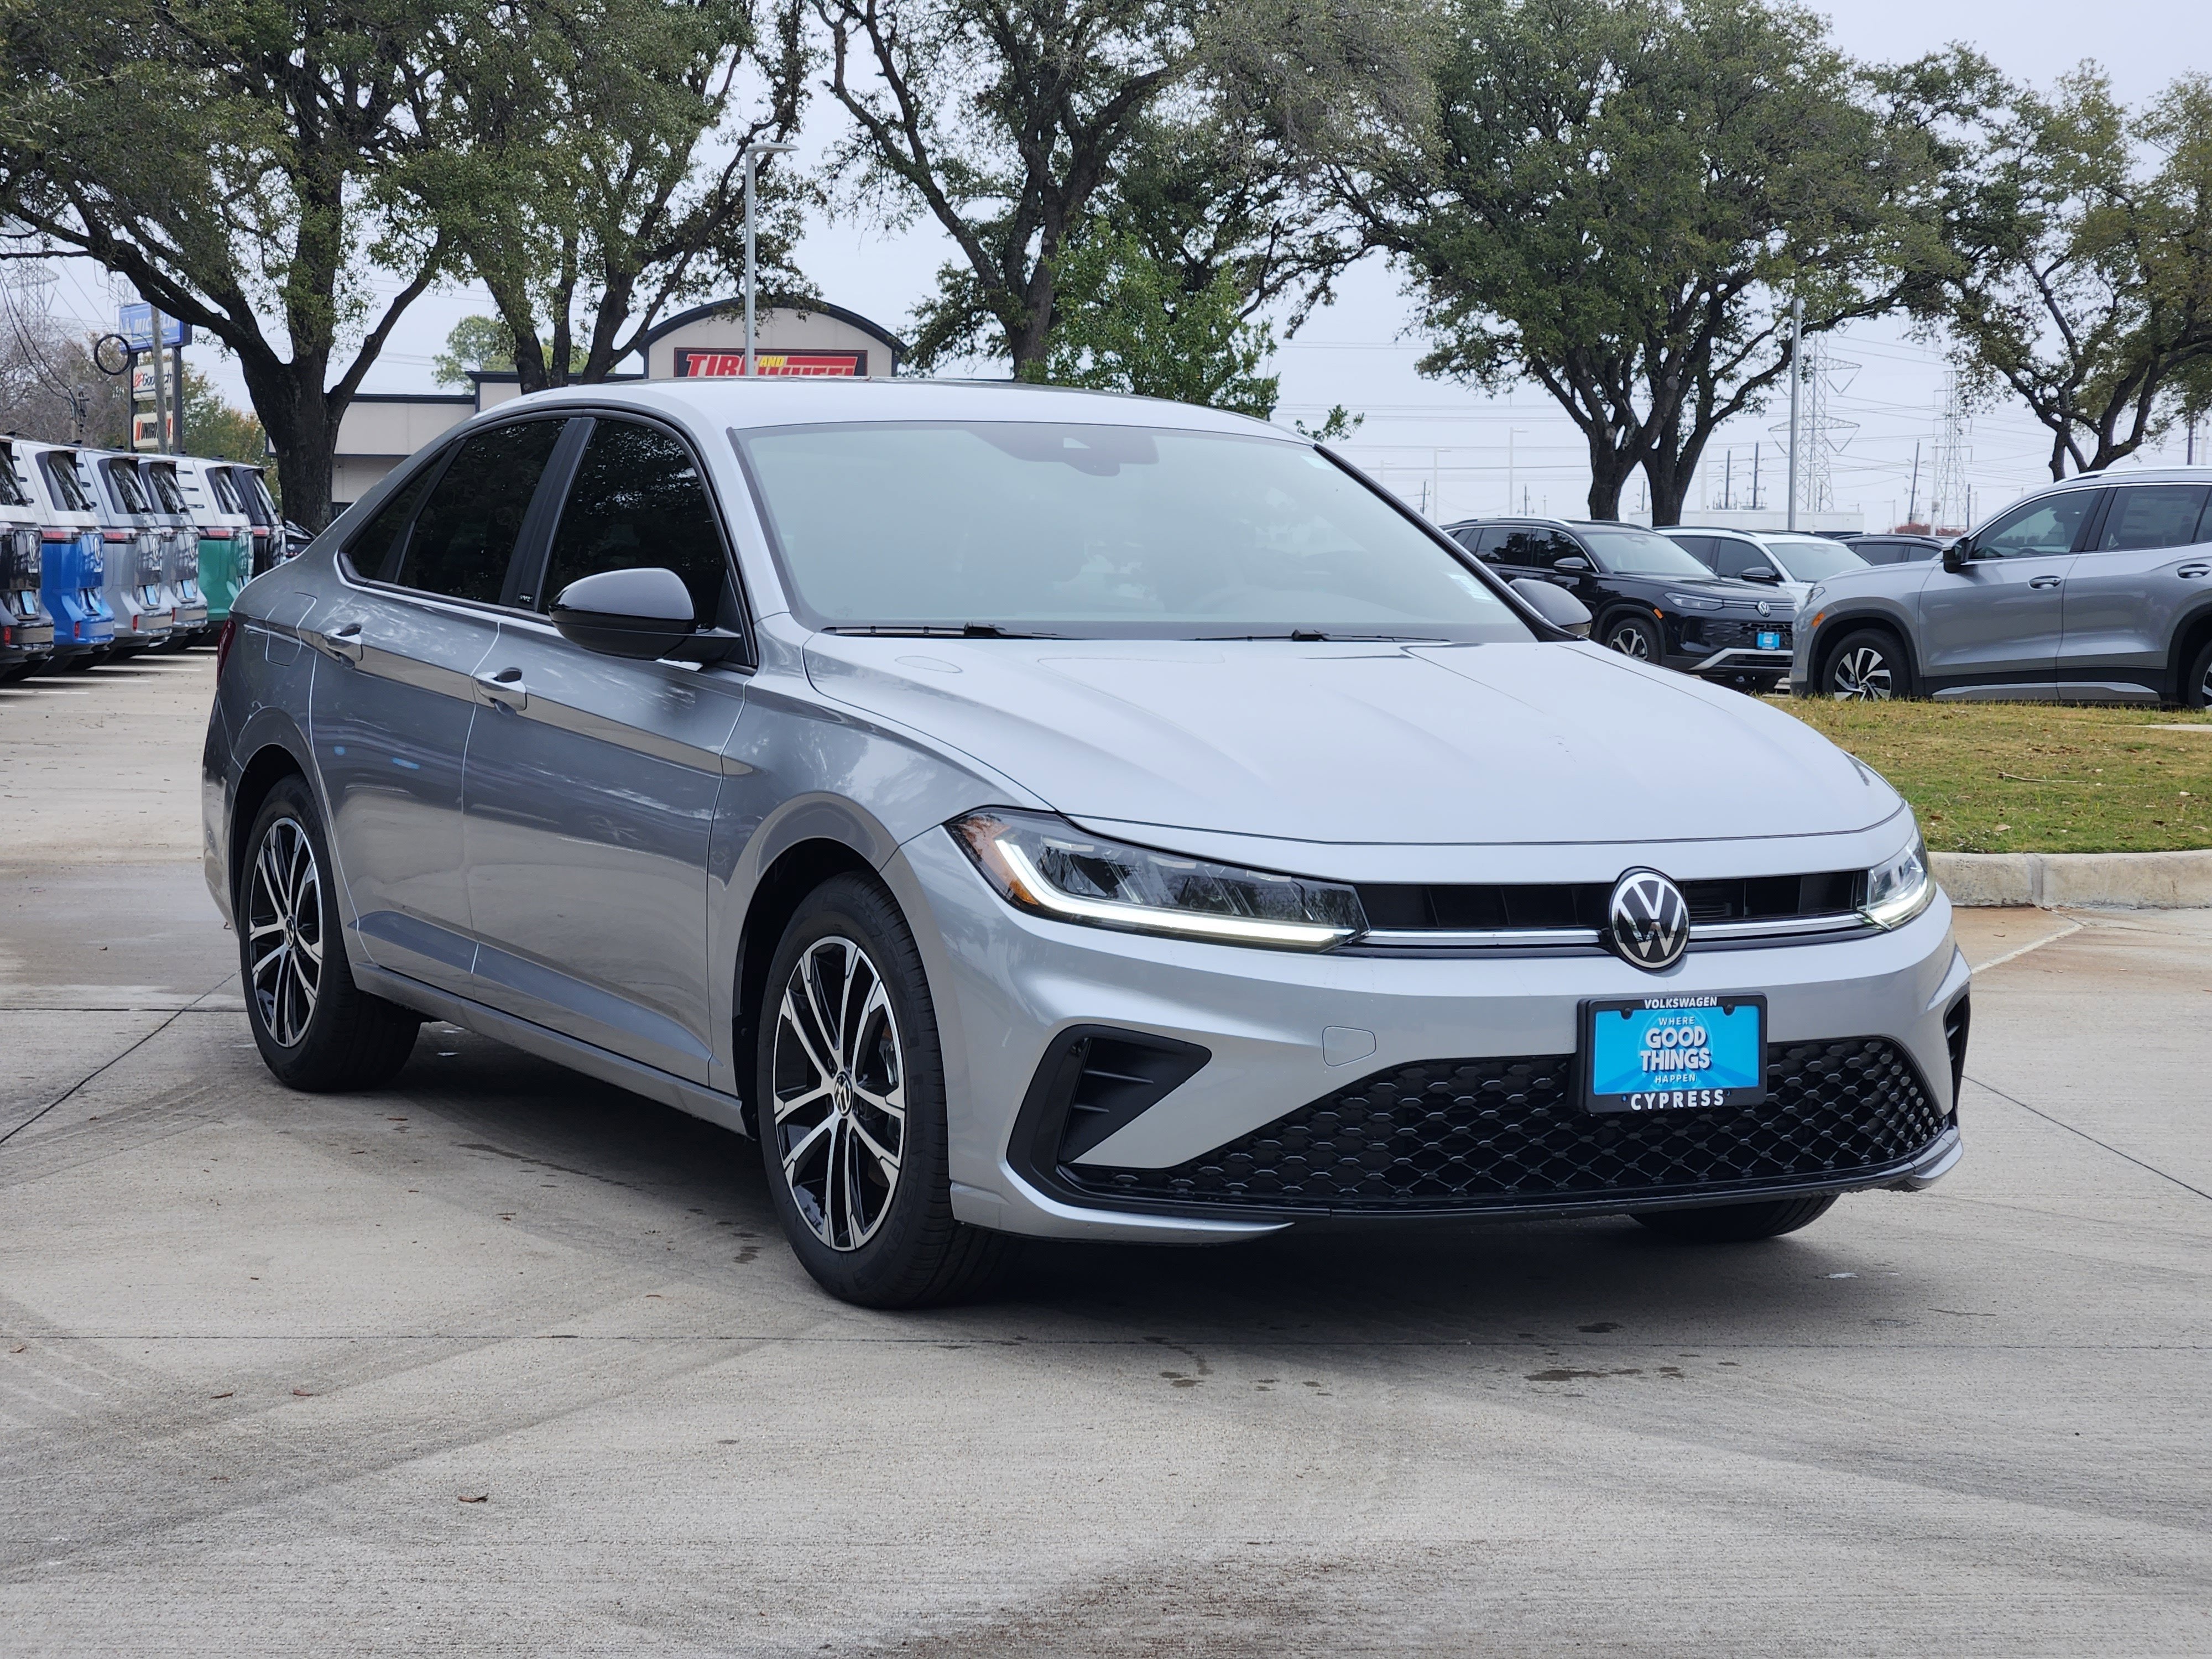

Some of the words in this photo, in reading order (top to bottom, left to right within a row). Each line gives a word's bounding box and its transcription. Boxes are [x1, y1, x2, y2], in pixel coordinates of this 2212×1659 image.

[759, 356, 785, 367] AND
[1611, 873, 1689, 968] VW
[1644, 997, 1718, 1009] VOLKSWAGEN
[1659, 1016, 1696, 1026] WHERE
[1646, 1026, 1707, 1048] GOOD
[1640, 1047, 1710, 1072] THINGS
[1655, 1074, 1697, 1084] HAPPEN
[1631, 1089, 1724, 1111] CYPRESS
